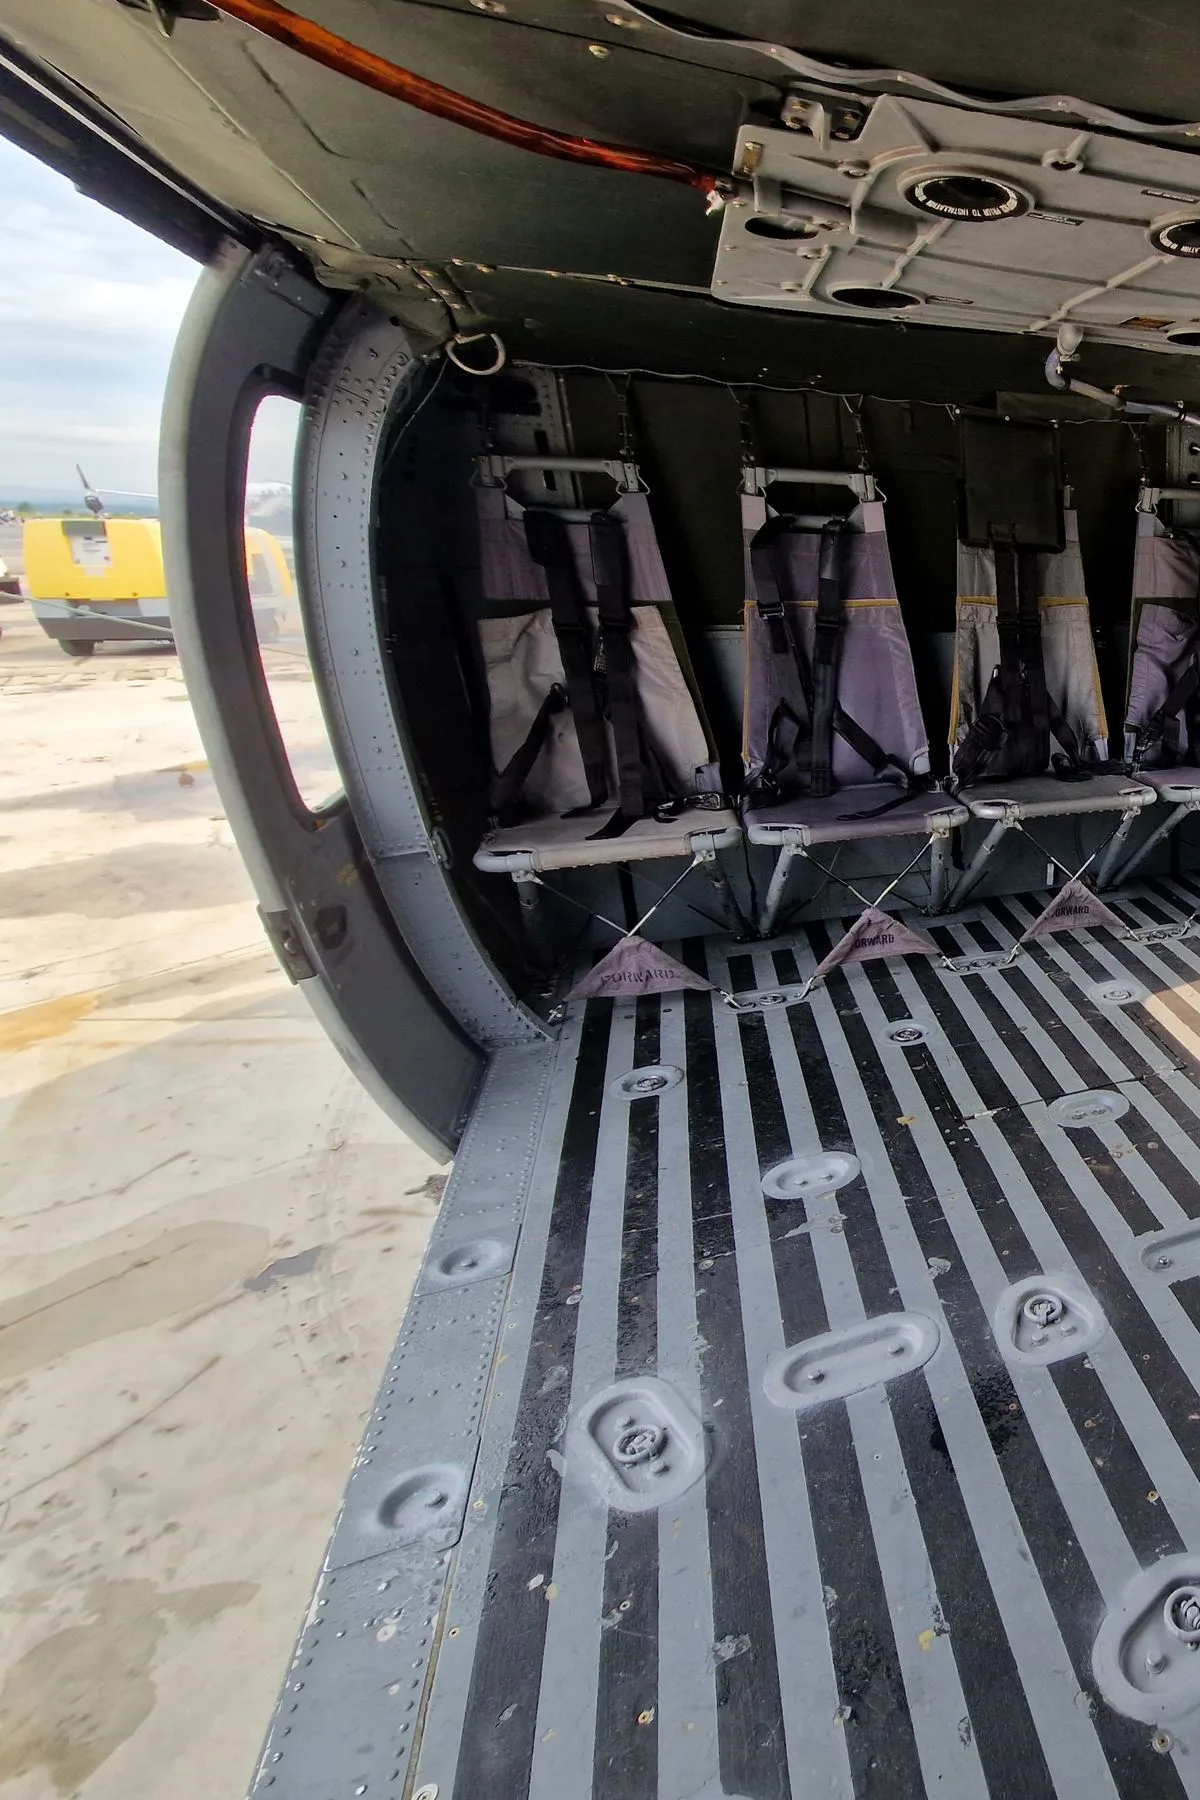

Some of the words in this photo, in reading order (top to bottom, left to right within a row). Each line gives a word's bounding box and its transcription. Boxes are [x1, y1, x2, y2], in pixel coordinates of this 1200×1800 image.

[972, 208, 981, 216] TO
[1052, 905, 1090, 918] ORWARD
[855, 934, 895, 949] ORWARD
